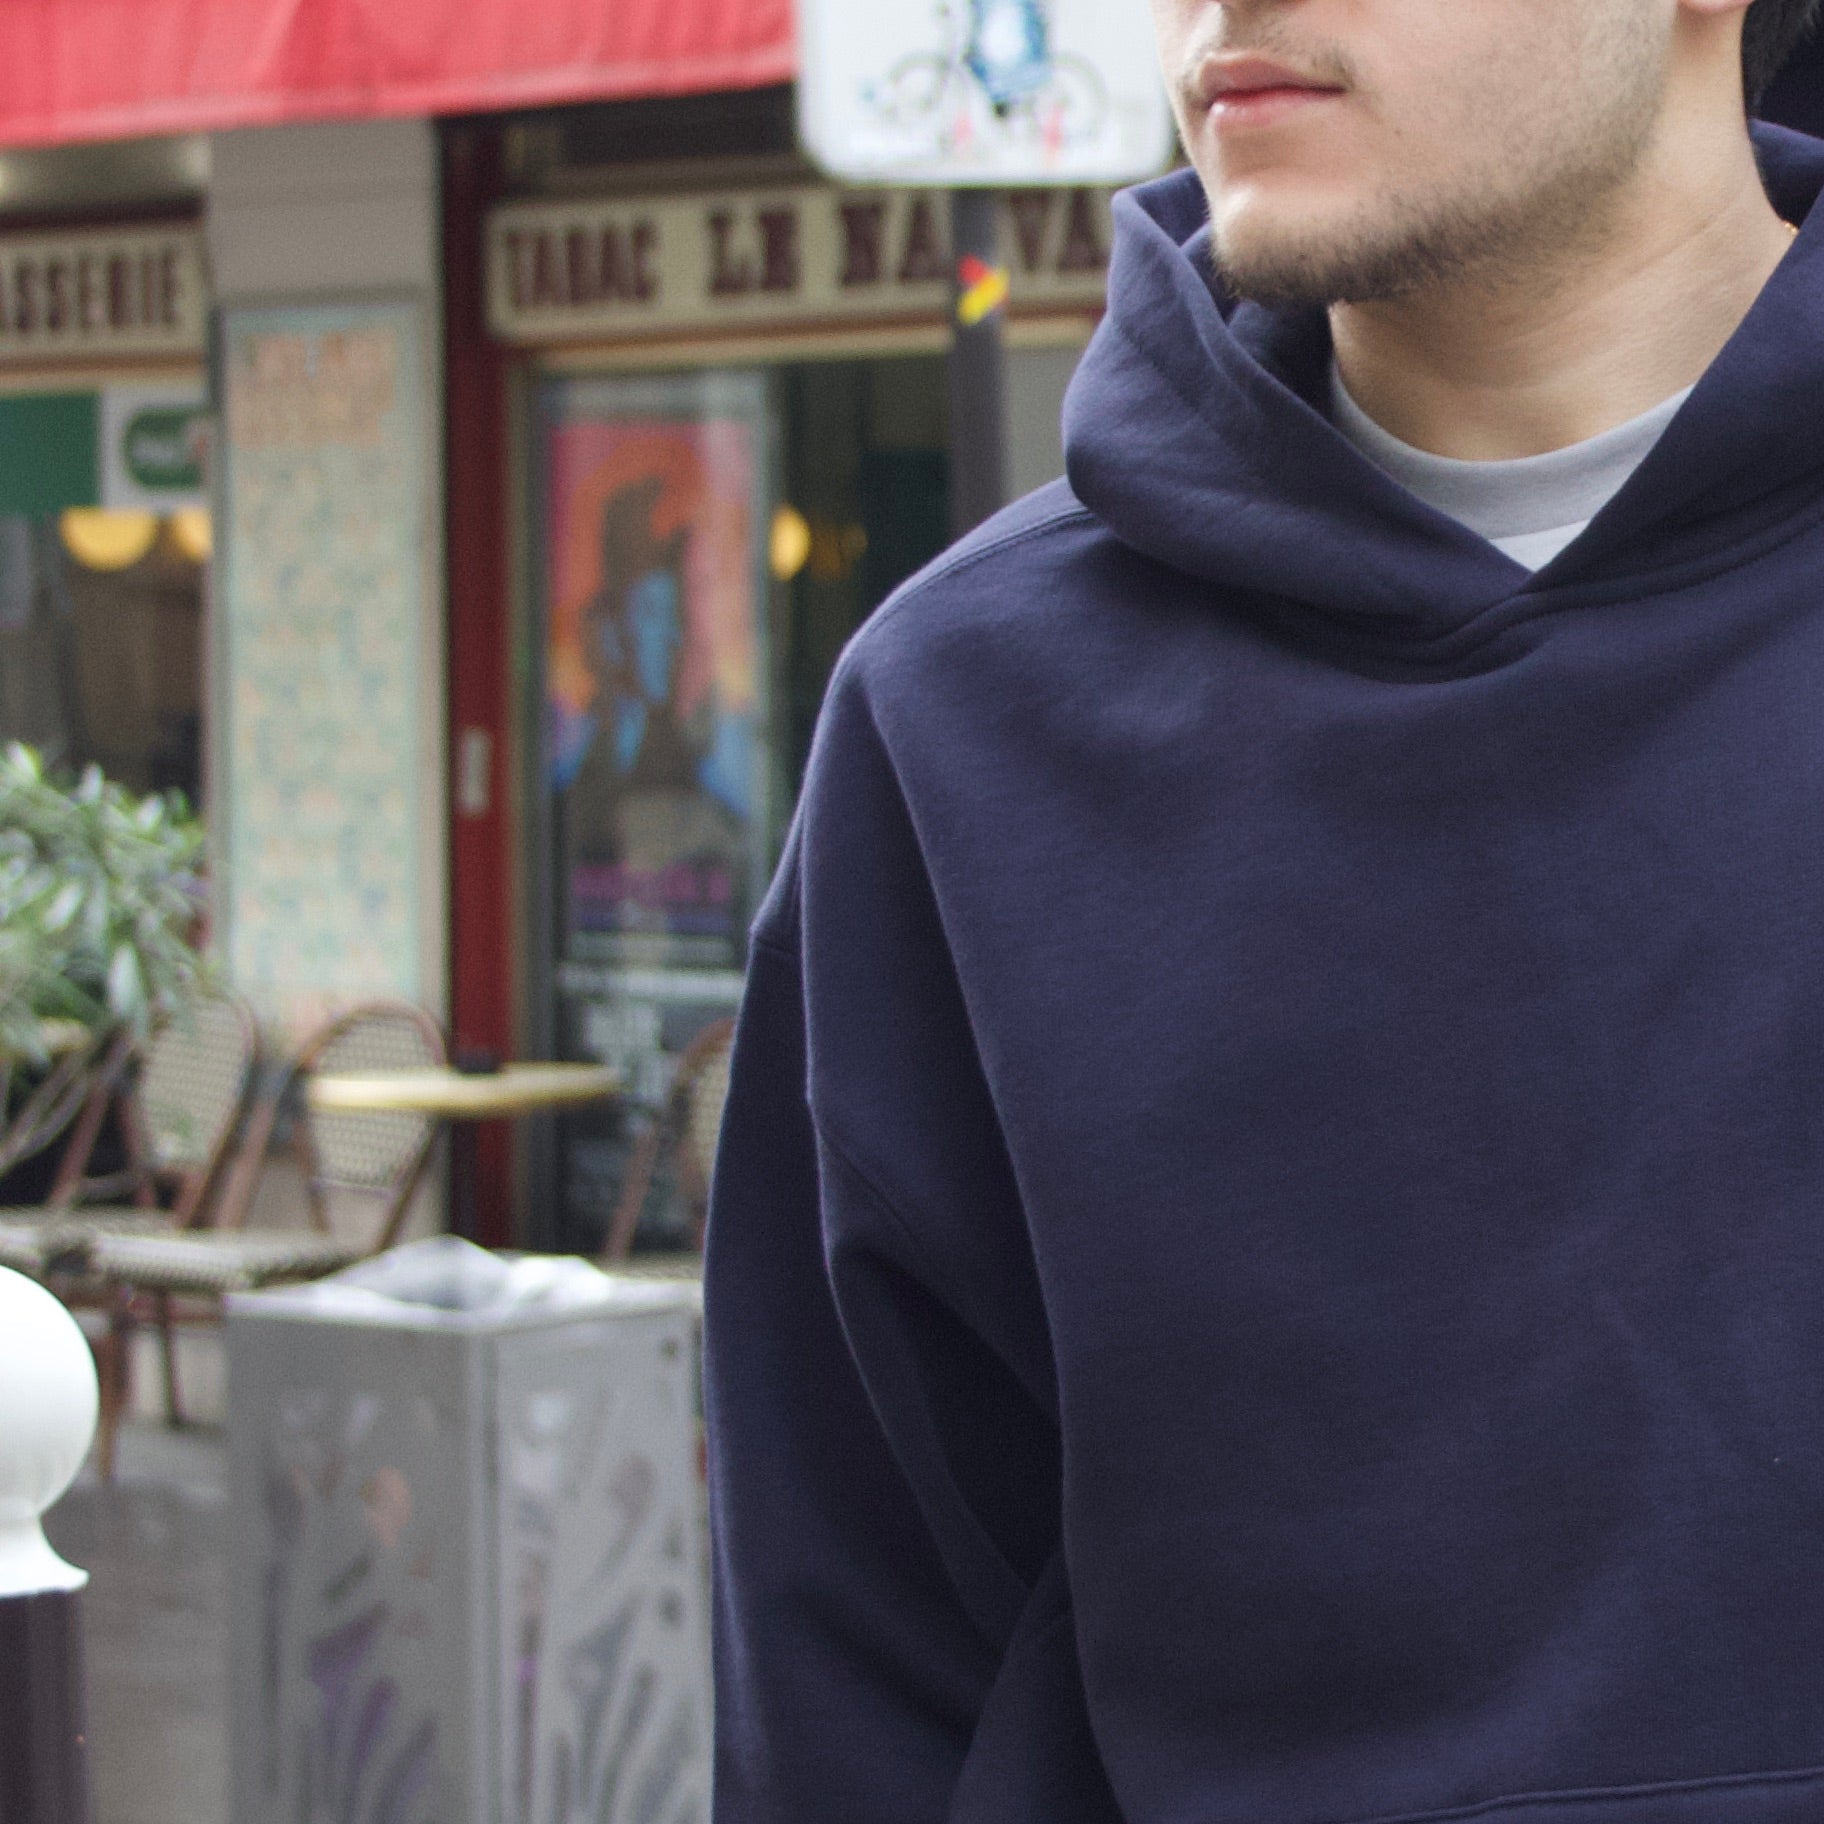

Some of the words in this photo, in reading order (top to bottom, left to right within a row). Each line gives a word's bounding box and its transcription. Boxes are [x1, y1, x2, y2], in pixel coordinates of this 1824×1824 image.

[0, 242, 181, 336] SSERIE
[504, 220, 660, 312] TABAC
[706, 204, 799, 298] LE
